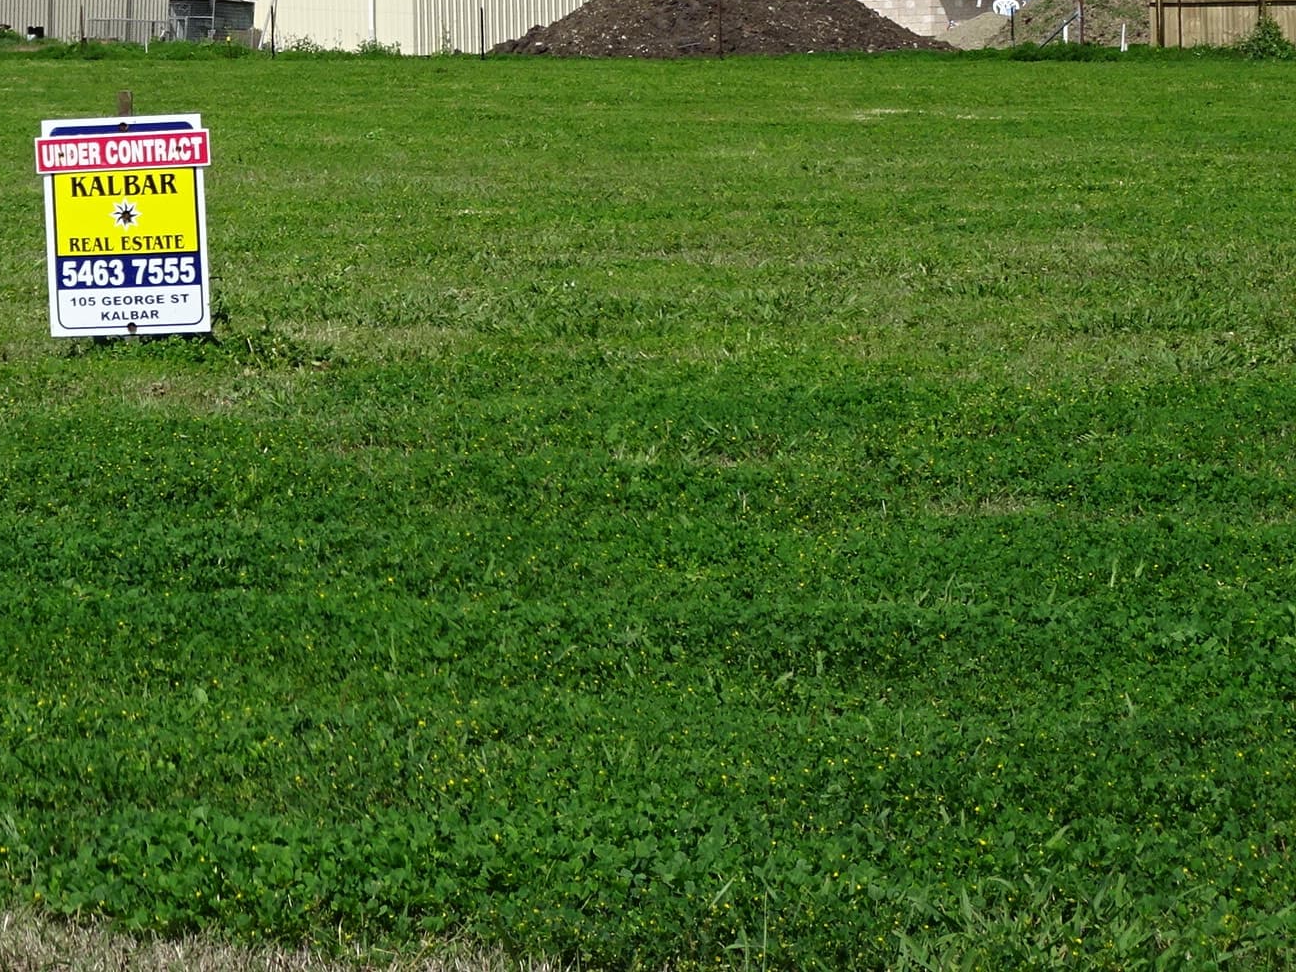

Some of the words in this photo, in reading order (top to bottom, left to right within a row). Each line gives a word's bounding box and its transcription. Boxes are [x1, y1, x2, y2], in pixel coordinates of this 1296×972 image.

[41, 141, 102, 168] UNDER
[104, 136, 203, 166] CONTRACT
[70, 173, 178, 197] KALBAR
[69, 236, 114, 253] REAL
[121, 234, 185, 251] ESTATE
[62, 259, 125, 287] 5463
[131, 256, 196, 285] 7555
[70, 296, 96, 307] 105
[101, 294, 165, 306] GEORGE
[170, 293, 190, 304] ST
[101, 309, 160, 321] KALBAR
